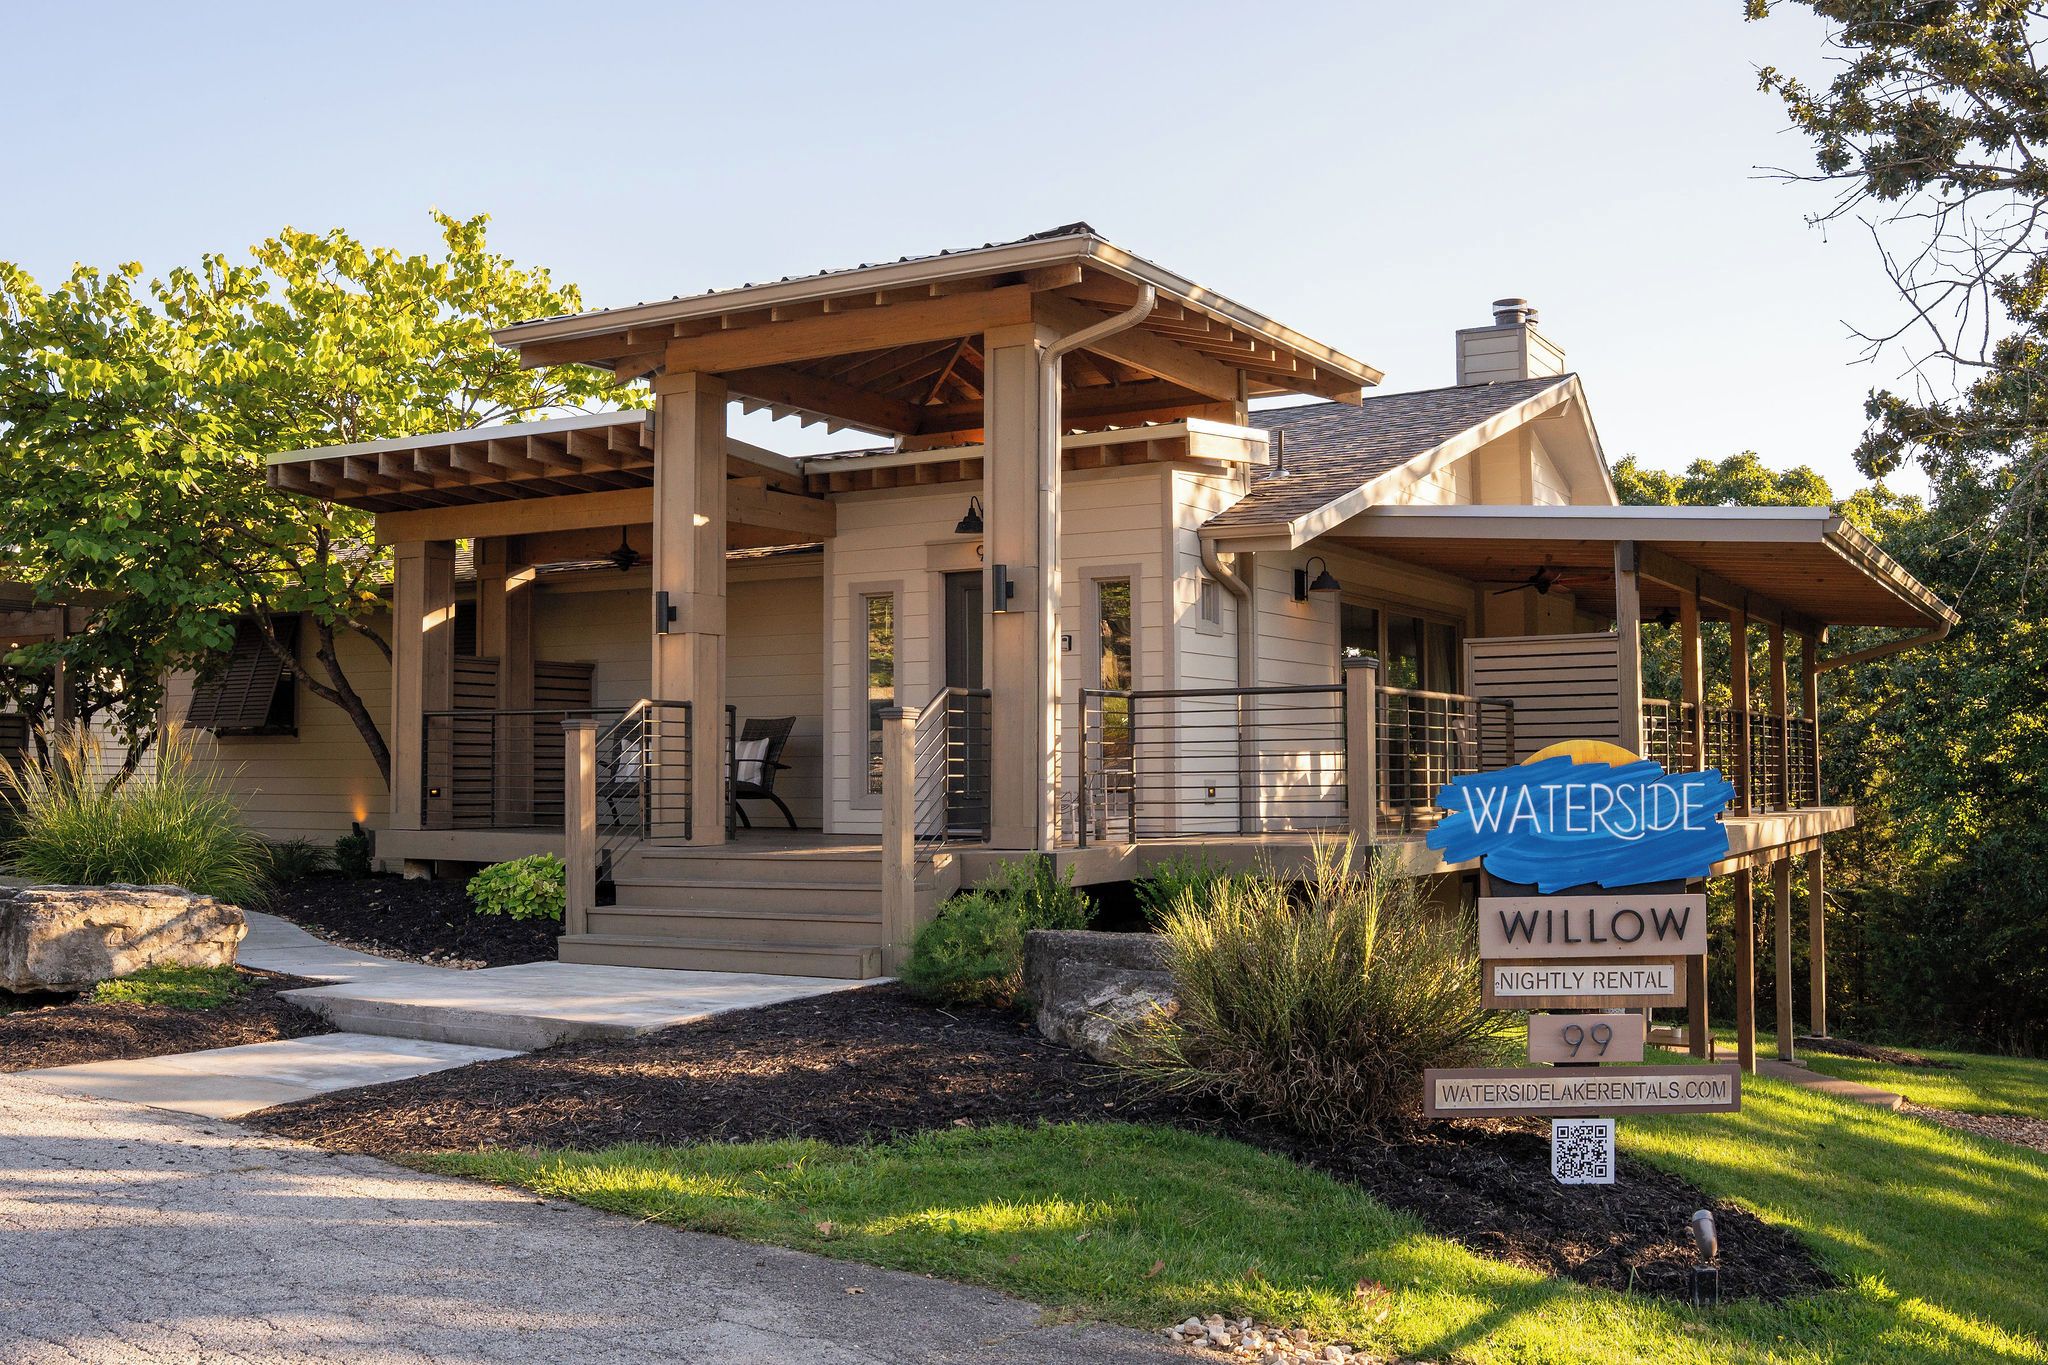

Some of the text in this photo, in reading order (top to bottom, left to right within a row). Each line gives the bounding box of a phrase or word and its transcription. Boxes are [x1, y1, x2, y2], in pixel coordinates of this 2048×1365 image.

[1462, 783, 1706, 841] WATERSIDE
[1499, 907, 1691, 944] WILLOW
[1500, 971, 1669, 990] NIGHTLY RENTAL
[1563, 1023, 1613, 1058] 99
[1442, 1080, 1726, 1103] WATERSIDELAKERENTALS.COM
